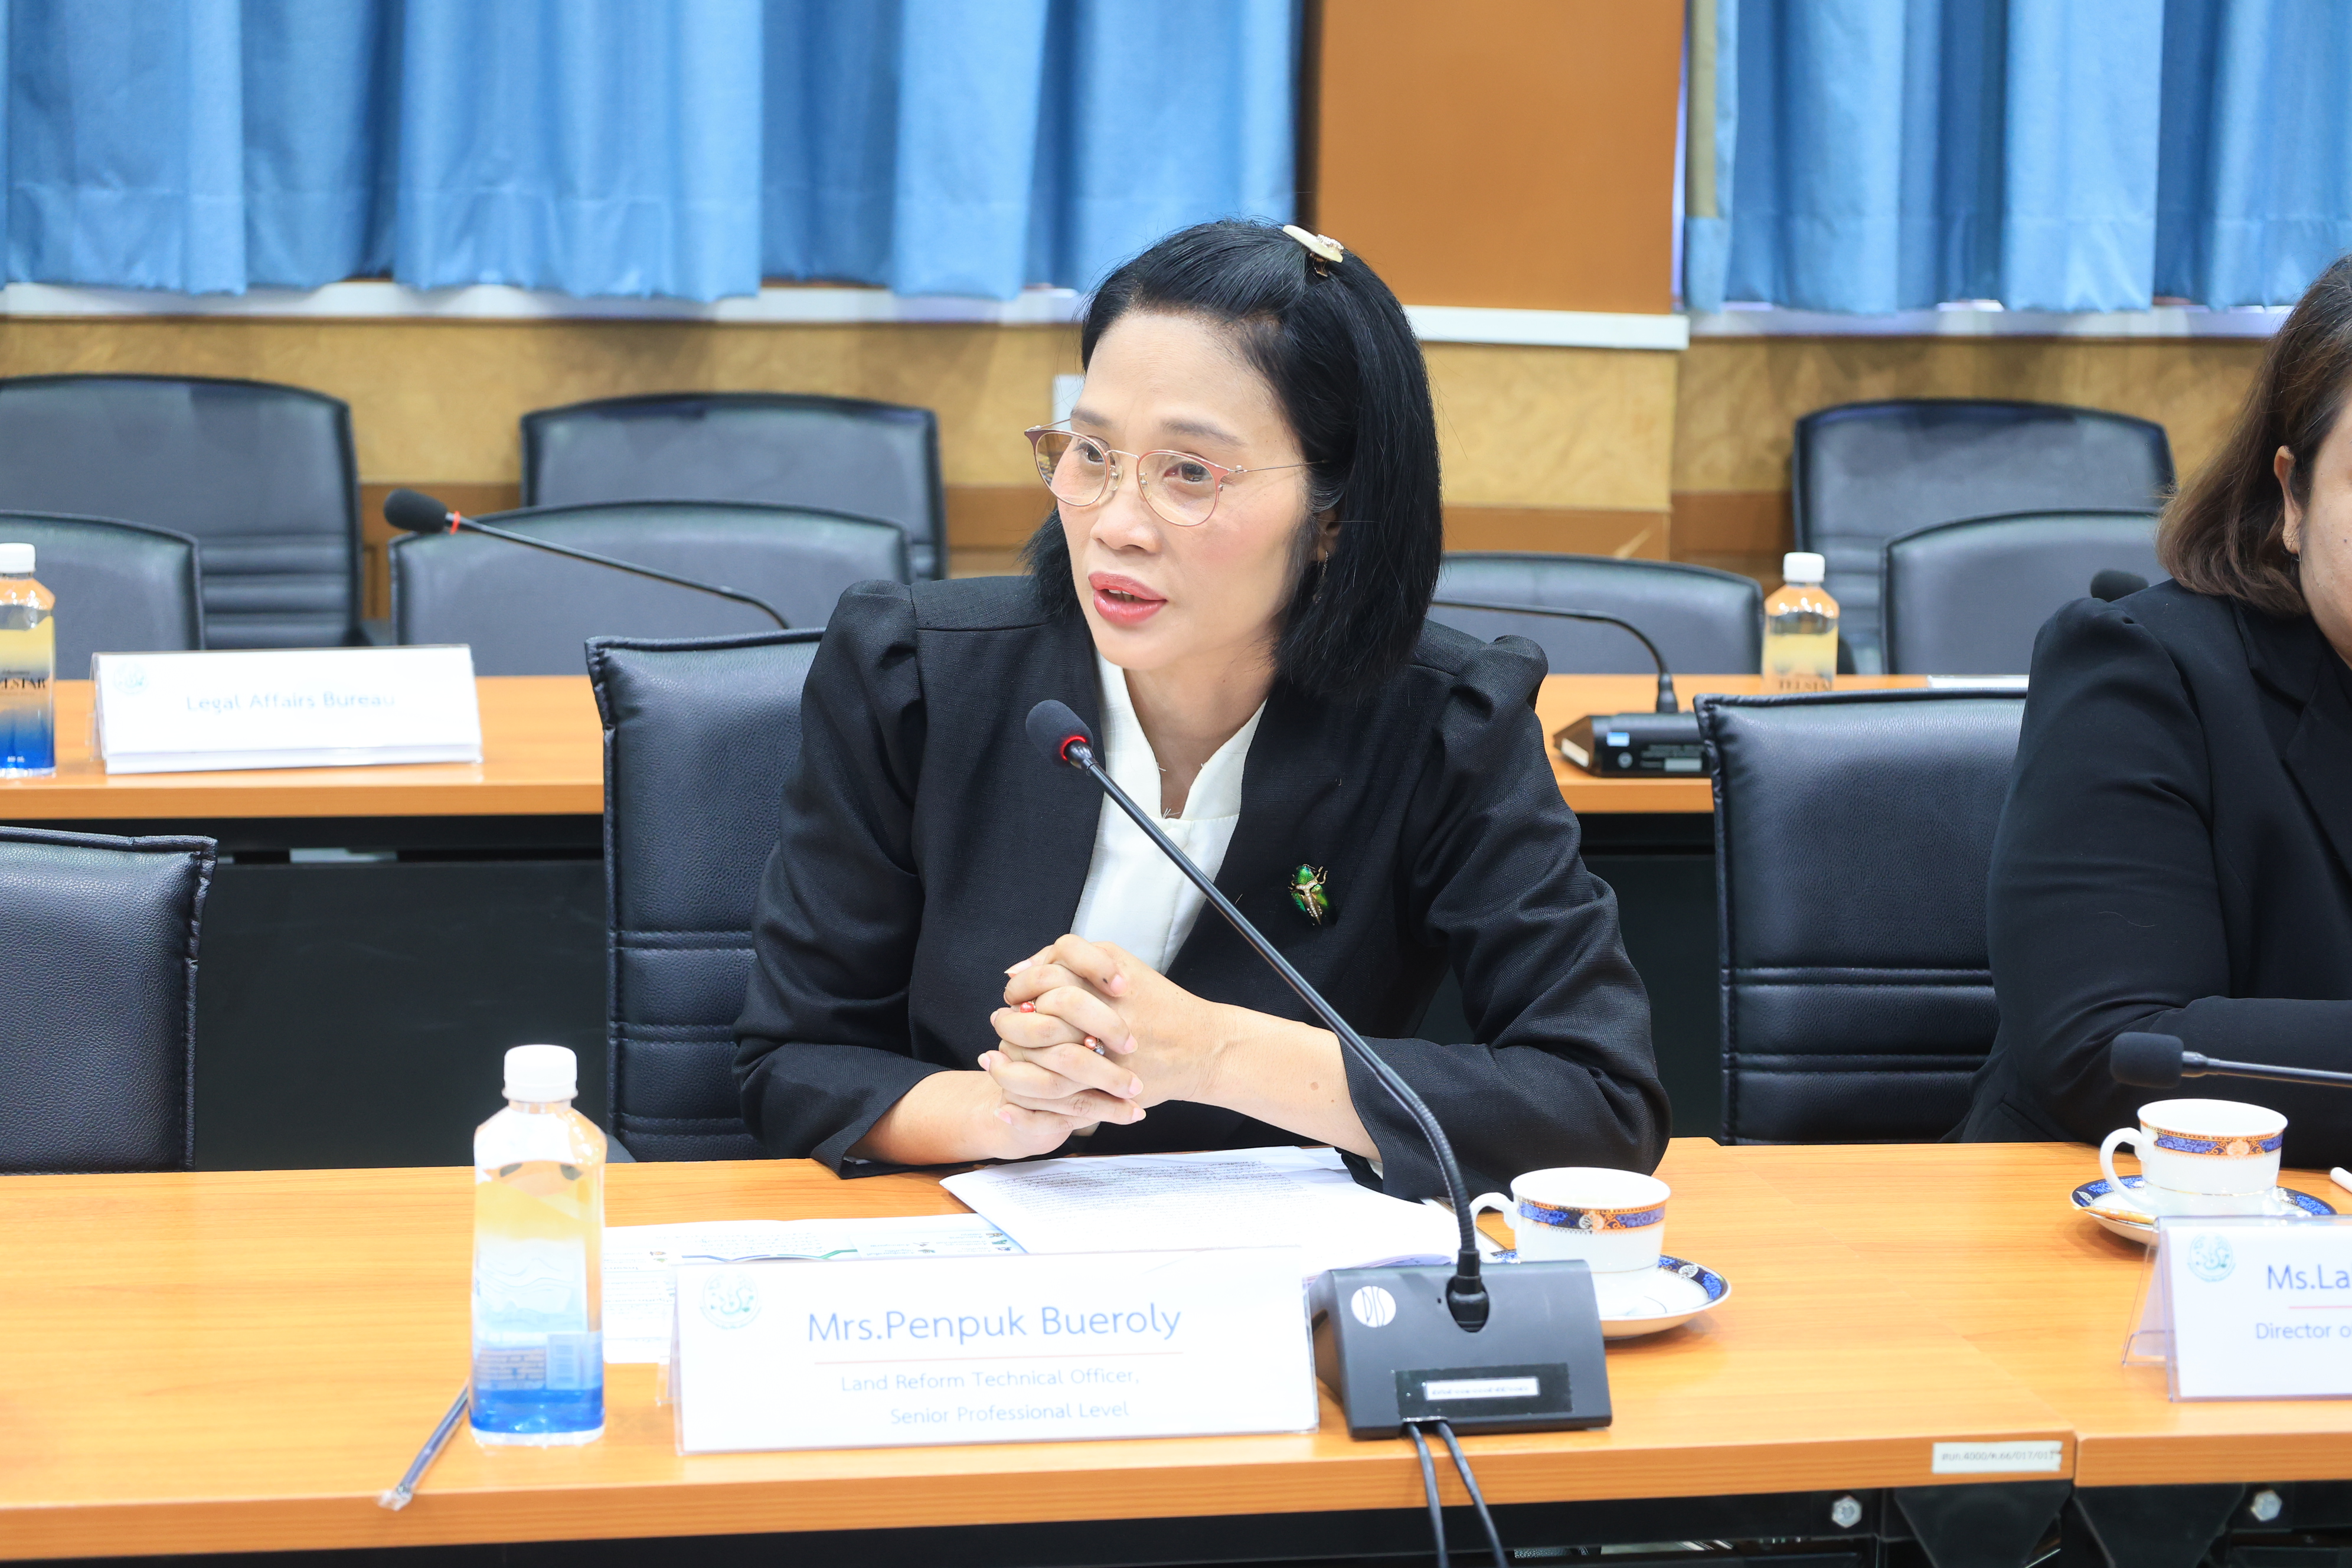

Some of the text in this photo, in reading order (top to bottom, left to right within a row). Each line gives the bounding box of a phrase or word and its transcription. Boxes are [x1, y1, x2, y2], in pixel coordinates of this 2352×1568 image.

[186, 690, 396, 714] Legal Affairs Bureau
[2267, 1263, 2352, 1291] Ms.La
[809, 1306, 1027, 1345] Mrs.Penpuk
[1041, 1302, 1181, 1341] Bueroly
[2255, 1322, 2352, 1340] Director o
[841, 1367, 1139, 1391] Land Reform Technical Officer,
[890, 1400, 1129, 1425] Senior Professional Level
